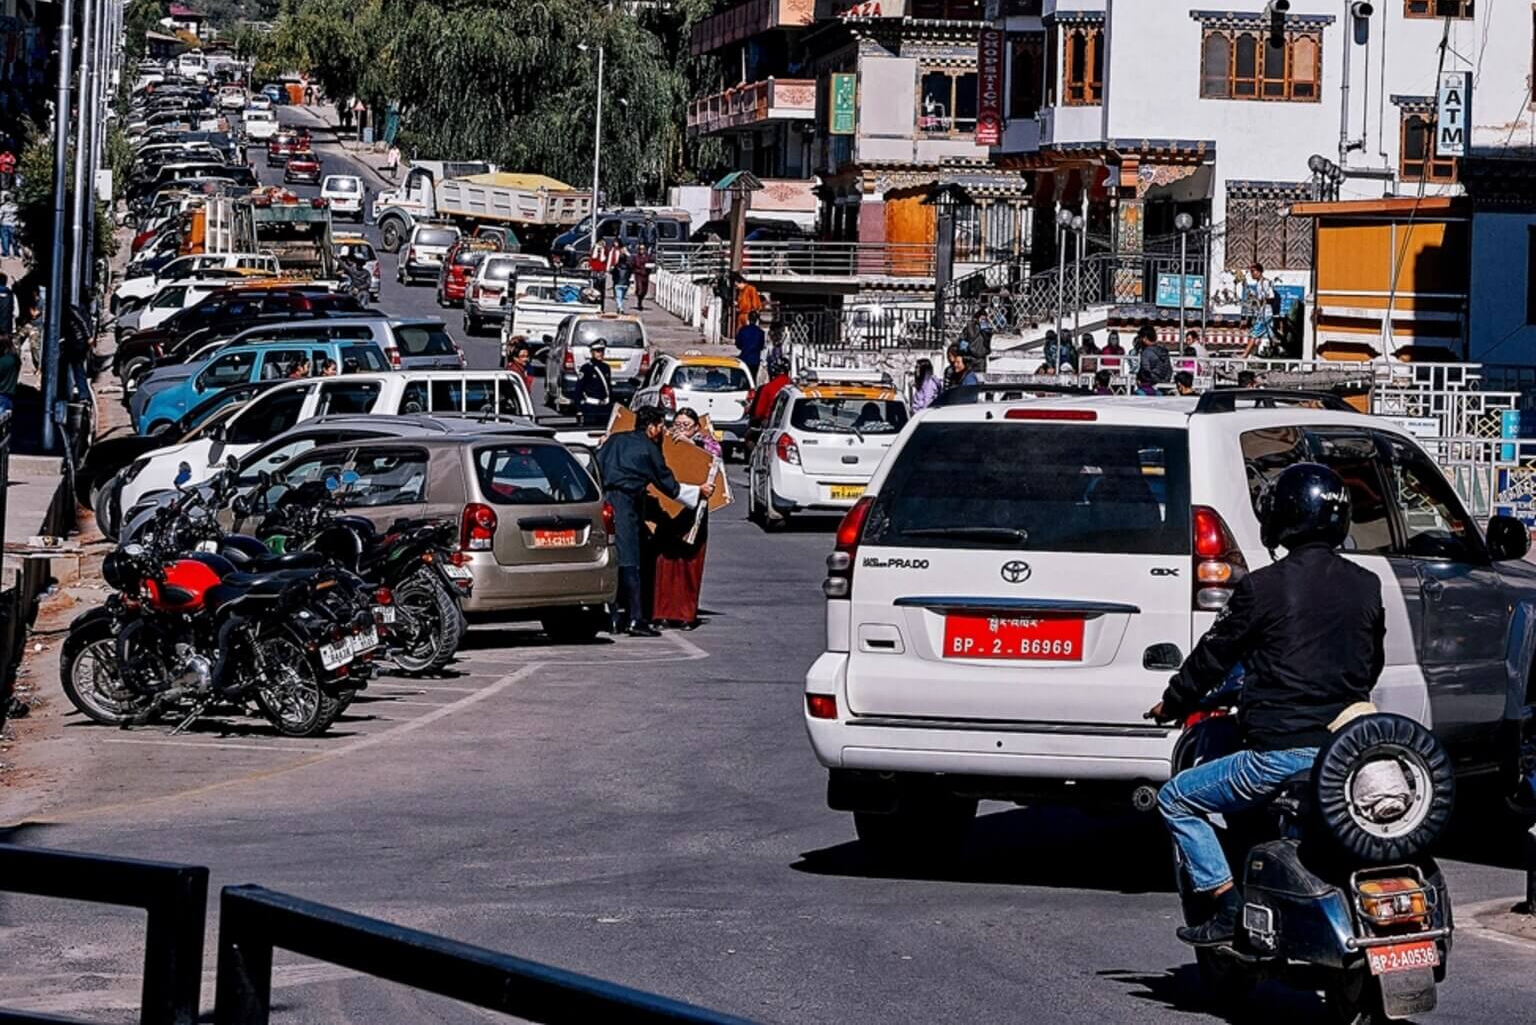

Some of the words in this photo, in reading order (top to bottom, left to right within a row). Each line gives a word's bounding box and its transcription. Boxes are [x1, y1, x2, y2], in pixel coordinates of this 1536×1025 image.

[1441, 89, 1464, 143] ATM
[888, 558, 930, 570] PRADO
[1020, 639, 1072, 655] B6969
